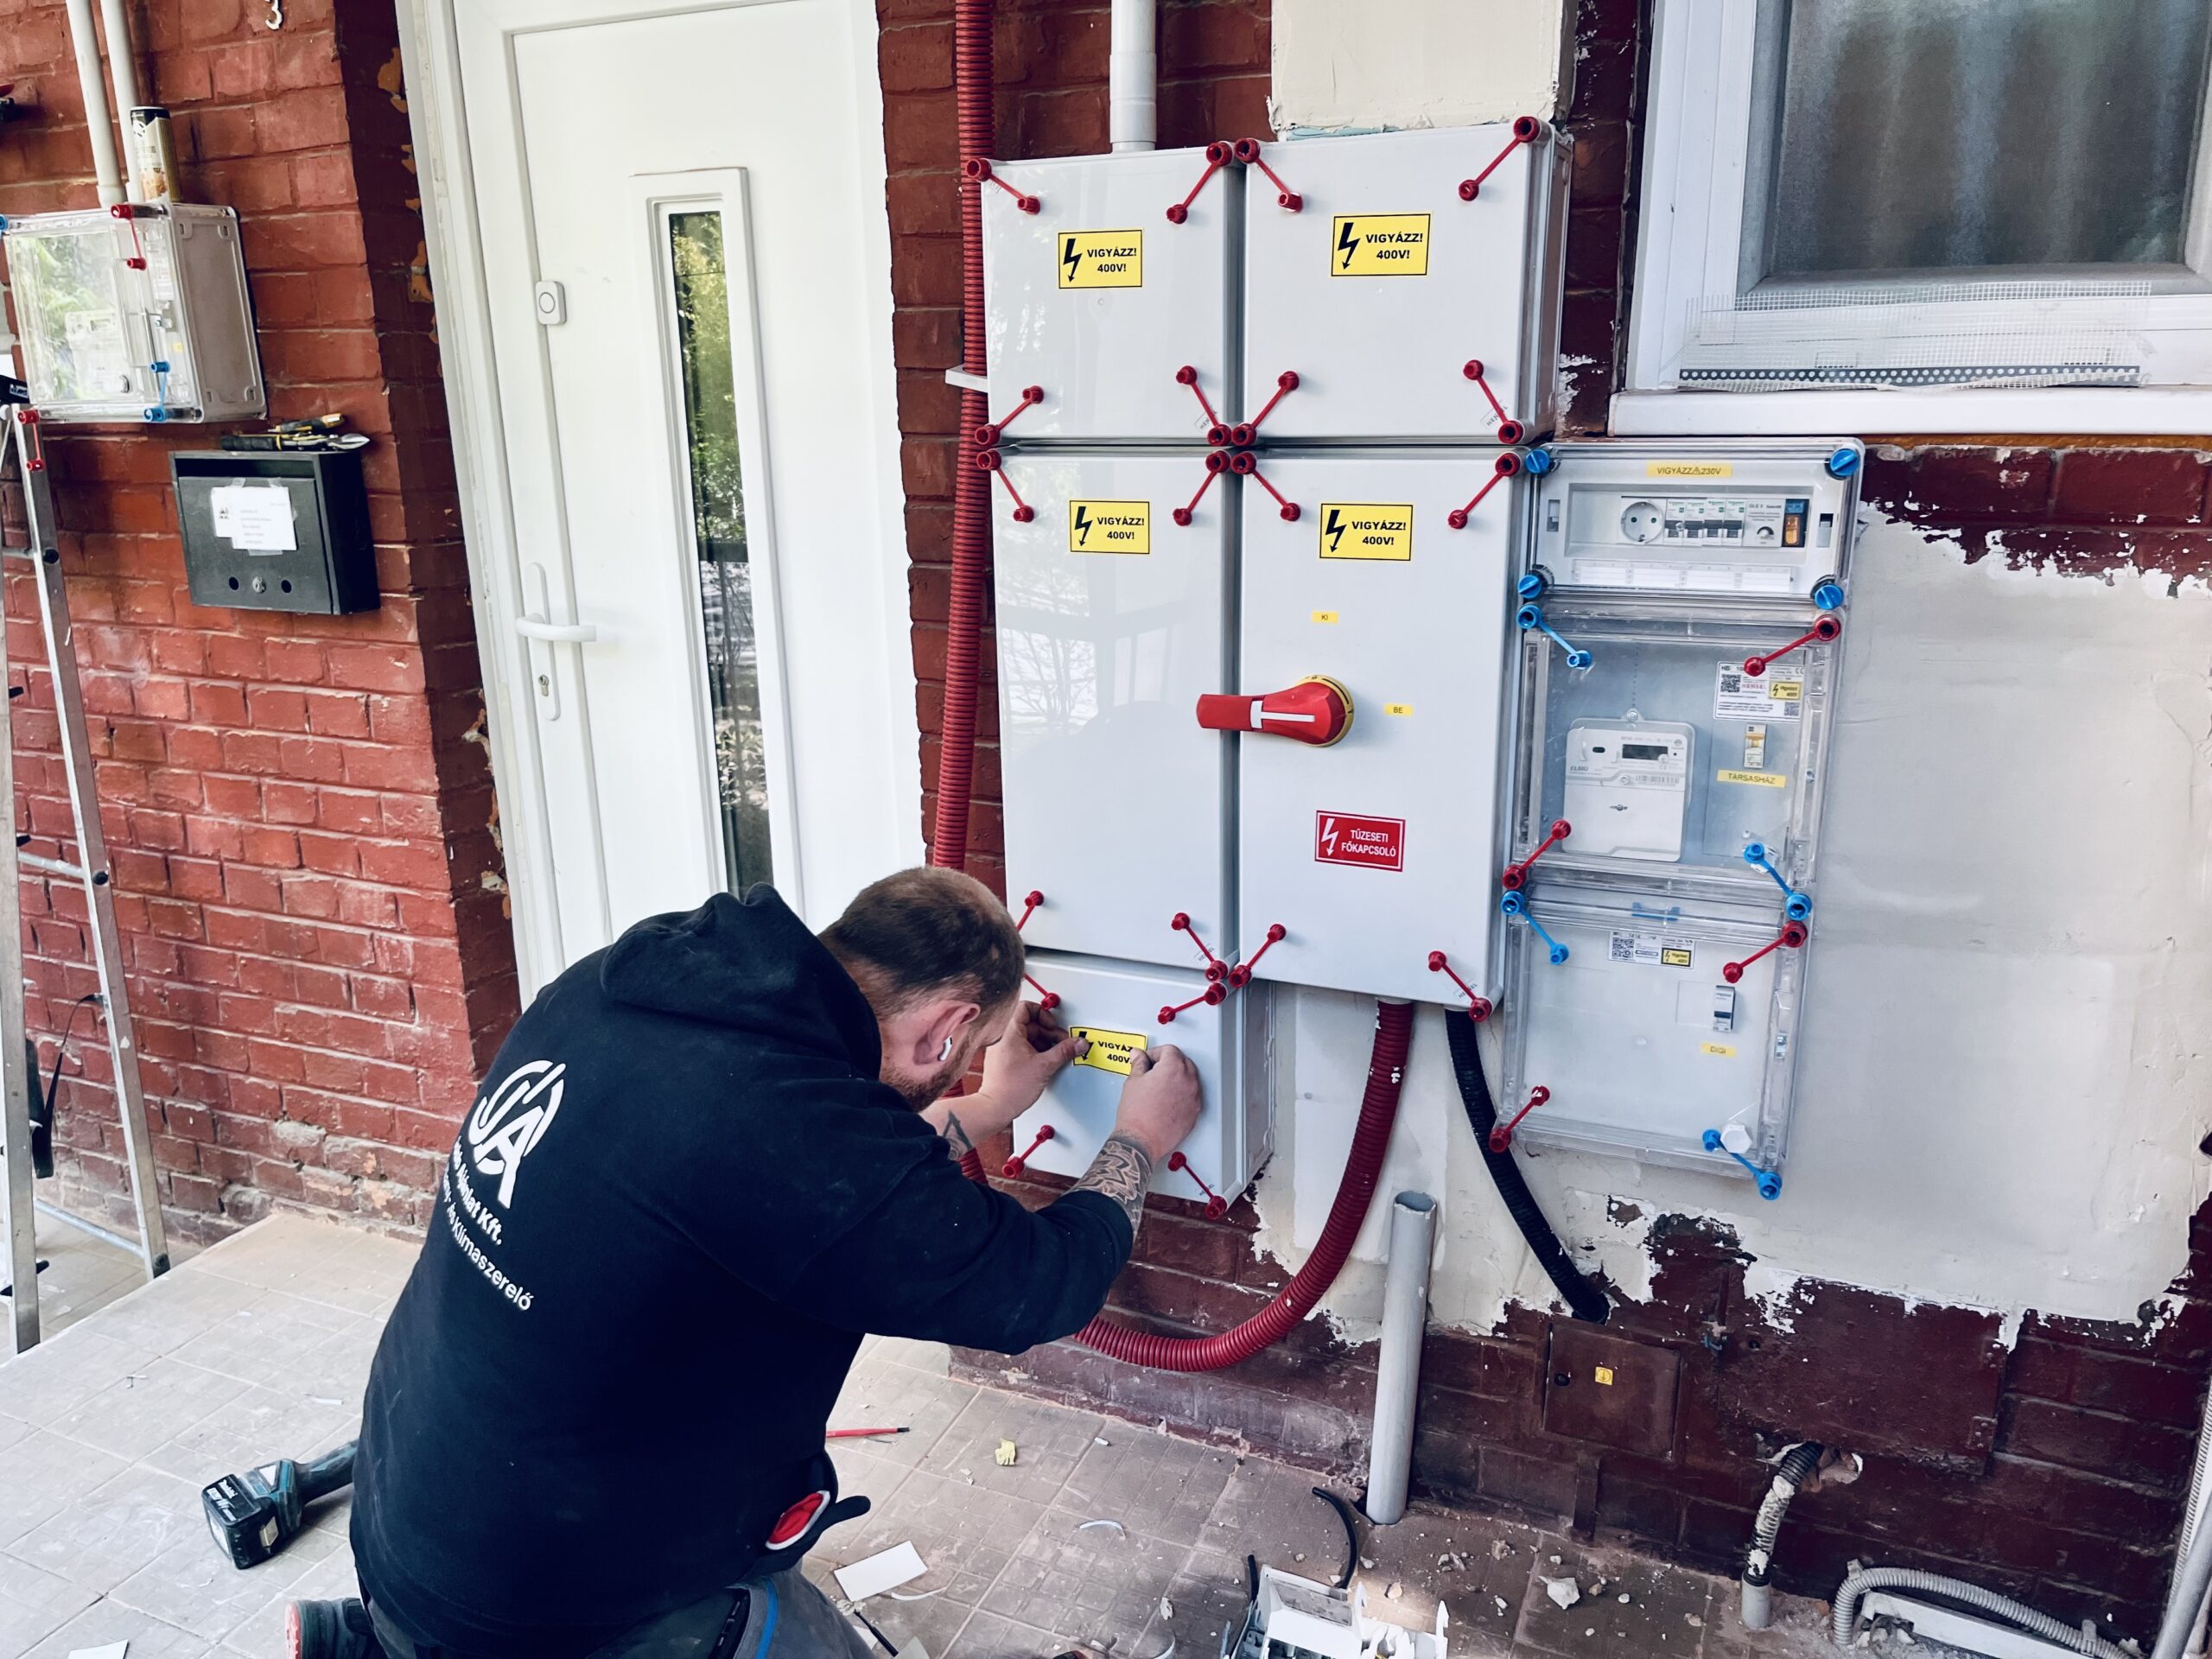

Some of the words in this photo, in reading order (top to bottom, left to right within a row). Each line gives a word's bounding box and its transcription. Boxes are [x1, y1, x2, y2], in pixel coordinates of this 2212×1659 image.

[1365, 231, 1423, 243] VIGYÁZZ!
[1087, 246, 1137, 257] VIGYÁZZ!
[1376, 250, 1410, 259] 400V!
[1096, 264, 1127, 272] 400V!
[1096, 516, 1145, 525] VIGYÁZZ!
[1351, 519, 1407, 531] VIGYÁZZ!
[1362, 536, 1395, 545] 400V!
[1728, 772, 1777, 785] TÁRSASHÁZ
[1350, 829, 1389, 842] TŰZESETI
[1341, 841, 1396, 857] FŐKAPCSOLÓ
[1097, 1040, 1134, 1052] VIGYÁZ
[1107, 1053, 1132, 1065] 400V
[477, 1207, 502, 1244] Kft.
[452, 1216, 535, 1311] Klímaszerelő
